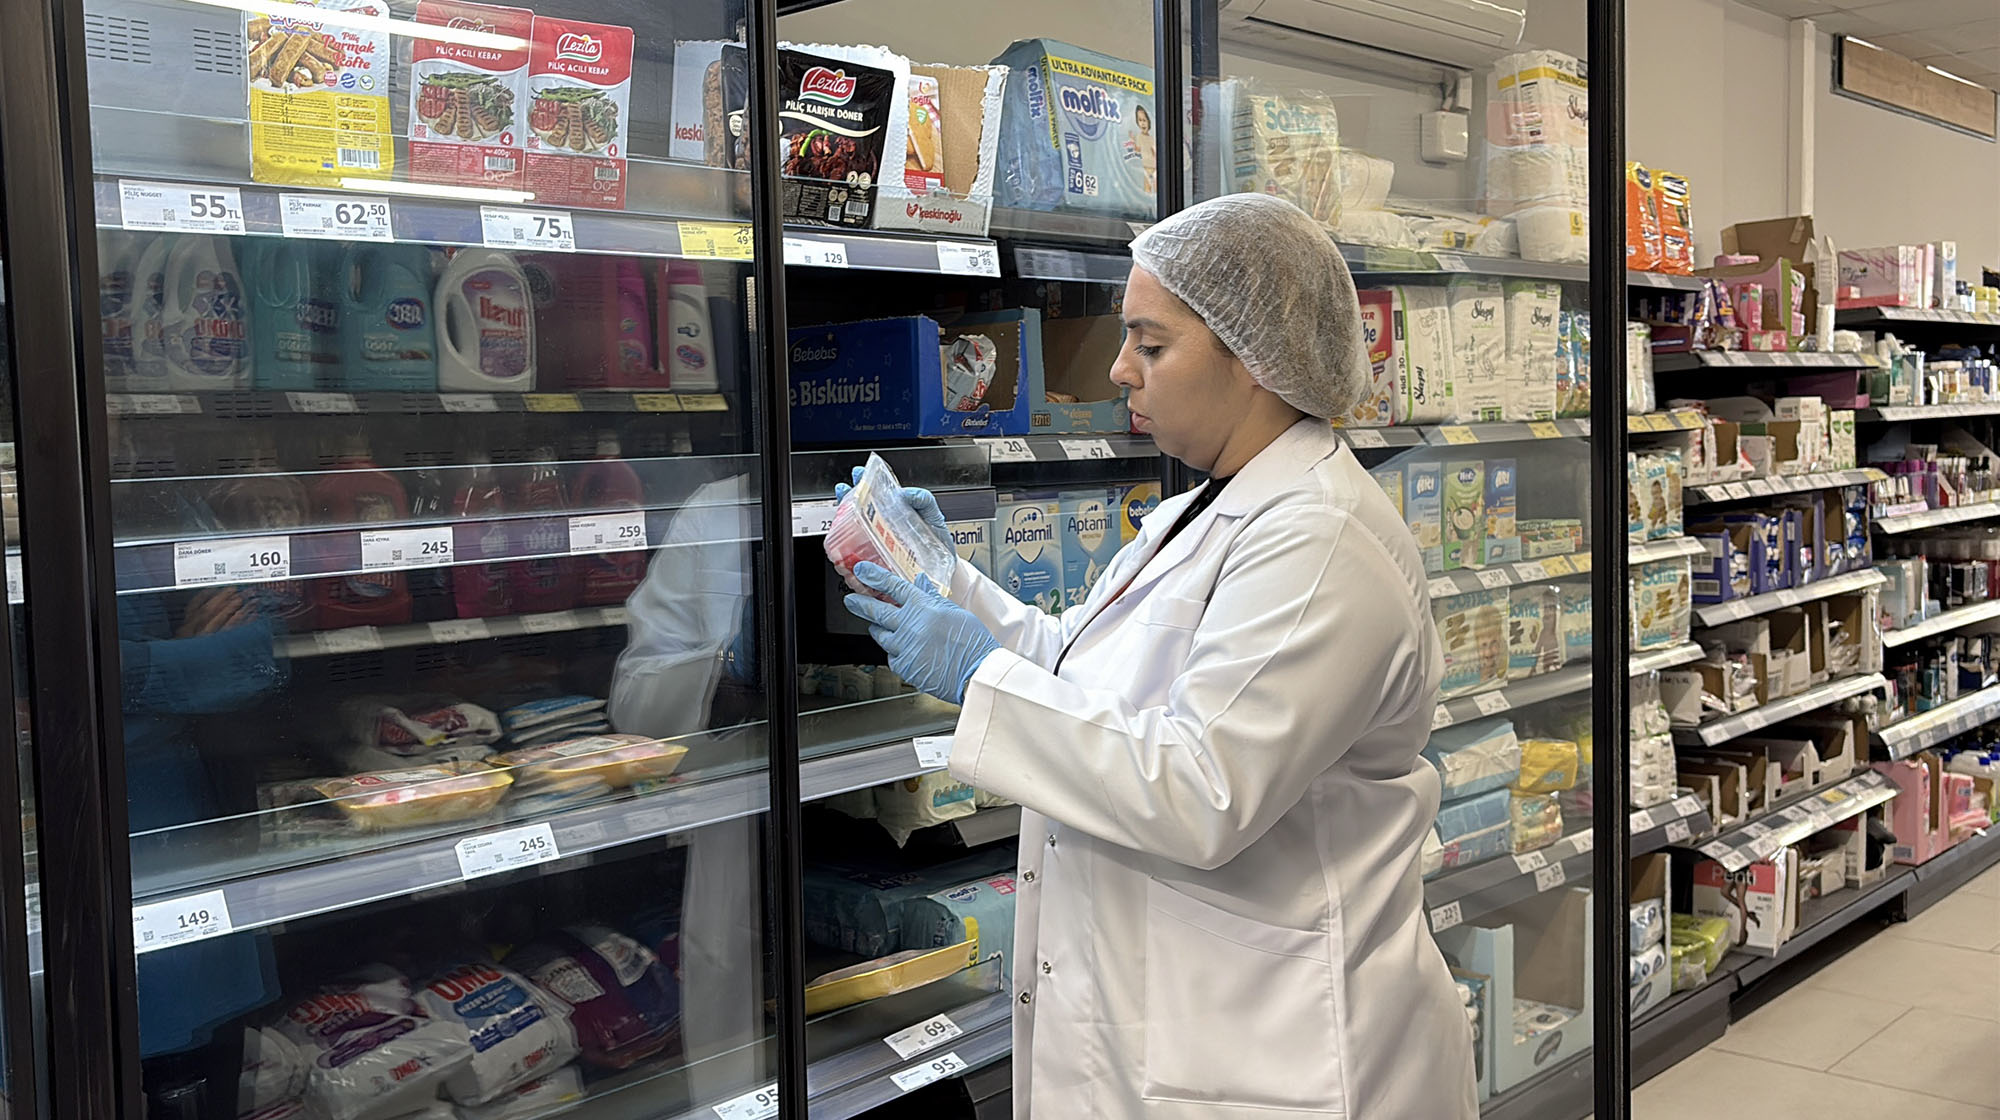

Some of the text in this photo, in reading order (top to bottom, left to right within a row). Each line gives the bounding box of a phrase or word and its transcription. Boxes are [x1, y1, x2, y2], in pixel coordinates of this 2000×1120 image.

[321, 34, 376, 55] Parmak
[563, 34, 598, 54] Lezita
[332, 52, 371, 69] Köfte
[455, 49, 476, 58] ACILI
[477, 51, 502, 61] KEBAP
[548, 62, 610, 76] PİLİÇ ACILI KEBAP
[1051, 58, 1147, 92] ULTRA ADVANTAGE PACK
[805, 68, 849, 94] Lezita
[1028, 66, 1044, 118] molfix
[911, 96, 930, 106] oğlu
[1062, 87, 1120, 120] molfix
[785, 100, 864, 122] PİLİÇ KARIŞIK DÖNER
[501, 134, 510, 145] 4
[609, 145, 617, 156] 4
[1075, 171, 1083, 188] 6
[1085, 175, 1097, 189] 62
[190, 193, 227, 218] 55
[227, 209, 241, 219] TL
[375, 217, 389, 226] TL
[919, 207, 963, 224] keskinoğlu
[533, 216, 561, 238] 75
[562, 230, 573, 239] TL
[737, 235, 749, 245] 49
[824, 252, 843, 264] 129
[799, 375, 881, 406] Bisküvisi
[1004, 440, 1023, 453] 20
[1090, 447, 1104, 458] 47
[618, 525, 641, 538] 259
[1067, 513, 1113, 533] Aptamil
[1005, 524, 1054, 547] Aptamil
[421, 541, 449, 554] 245
[249, 551, 281, 567] 160
[1050, 588, 1062, 614] 2
[519, 835, 546, 852] 245
[1711, 865, 1757, 886] Penti
[178, 909, 209, 929] 149
[924, 1021, 946, 1038] 69
[931, 1058, 956, 1074] 95
